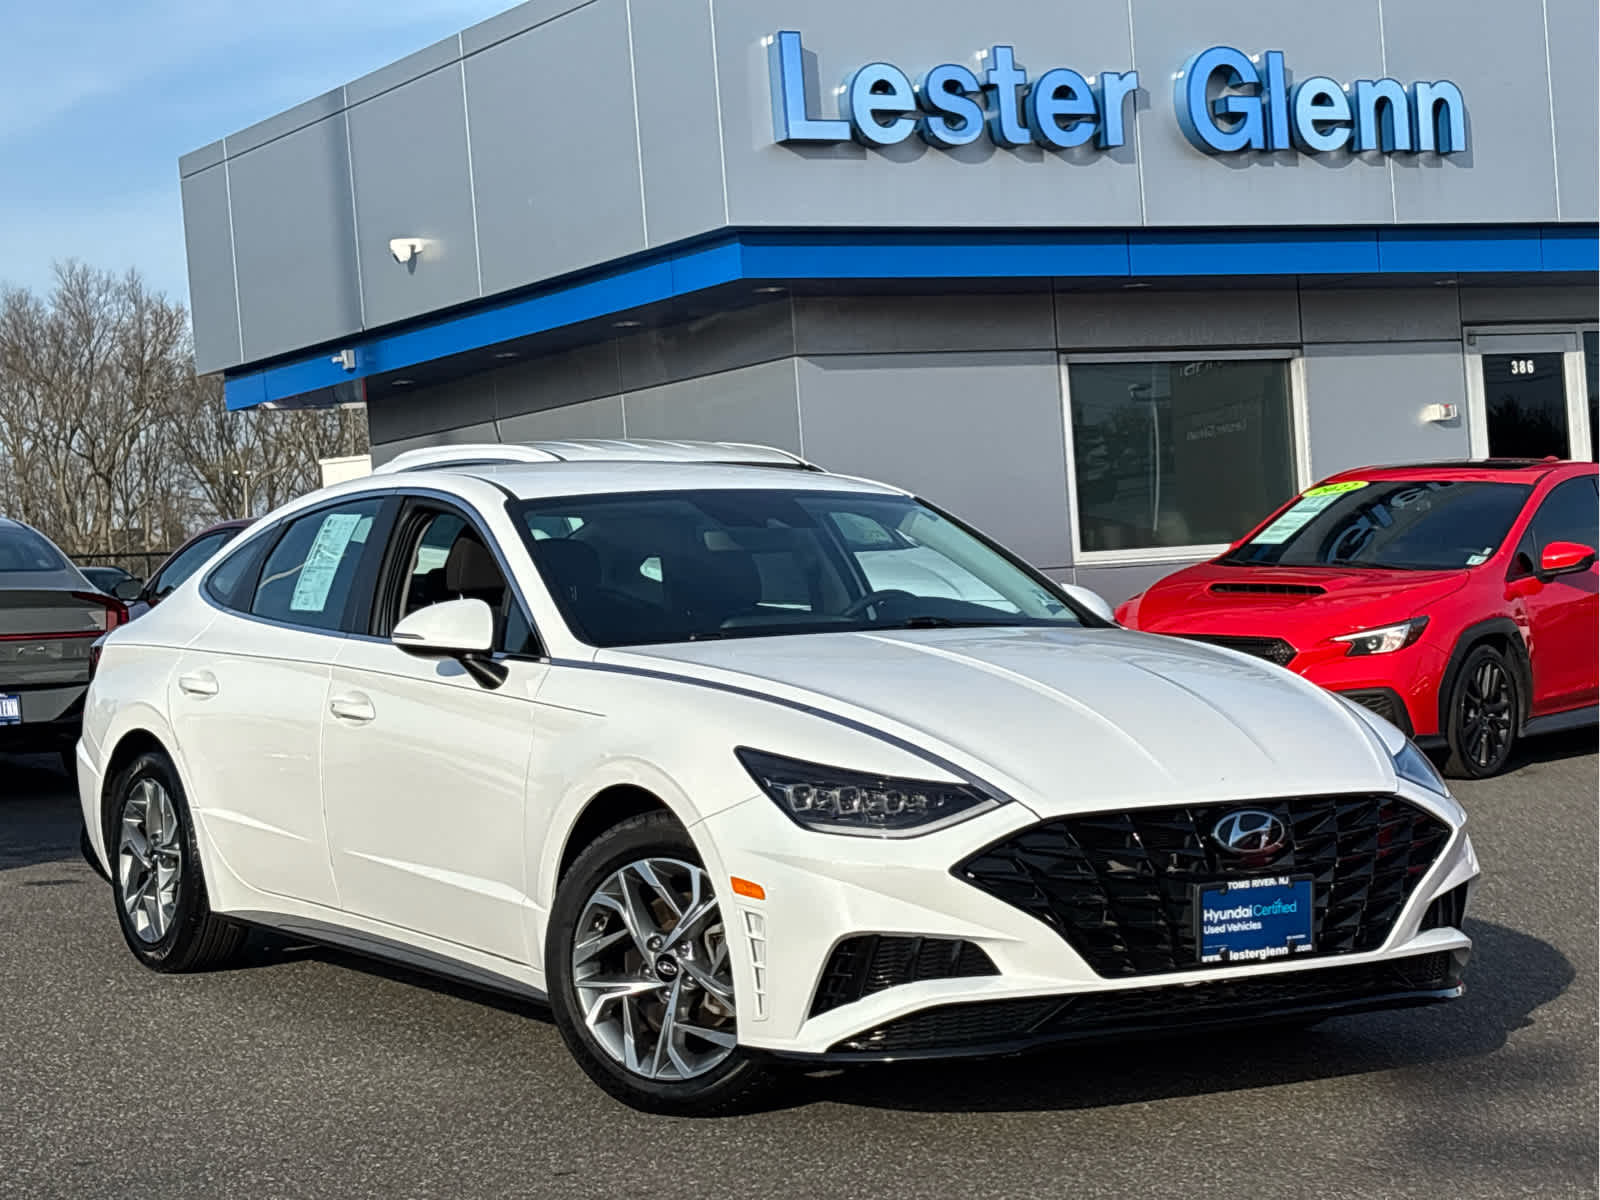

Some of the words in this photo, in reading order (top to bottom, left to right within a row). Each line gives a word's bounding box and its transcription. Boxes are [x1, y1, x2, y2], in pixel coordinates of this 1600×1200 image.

[770, 30, 1137, 149] Lester
[1178, 46, 1467, 155] Glenn
[1511, 360, 1534, 374] 386
[1227, 880, 1250, 890] TOMS
[1278, 876, 1289, 885] NJ
[1203, 923, 1226, 934] Used
[1226, 920, 1262, 932] Vehicles
[1229, 946, 1289, 961] lesterglenn
